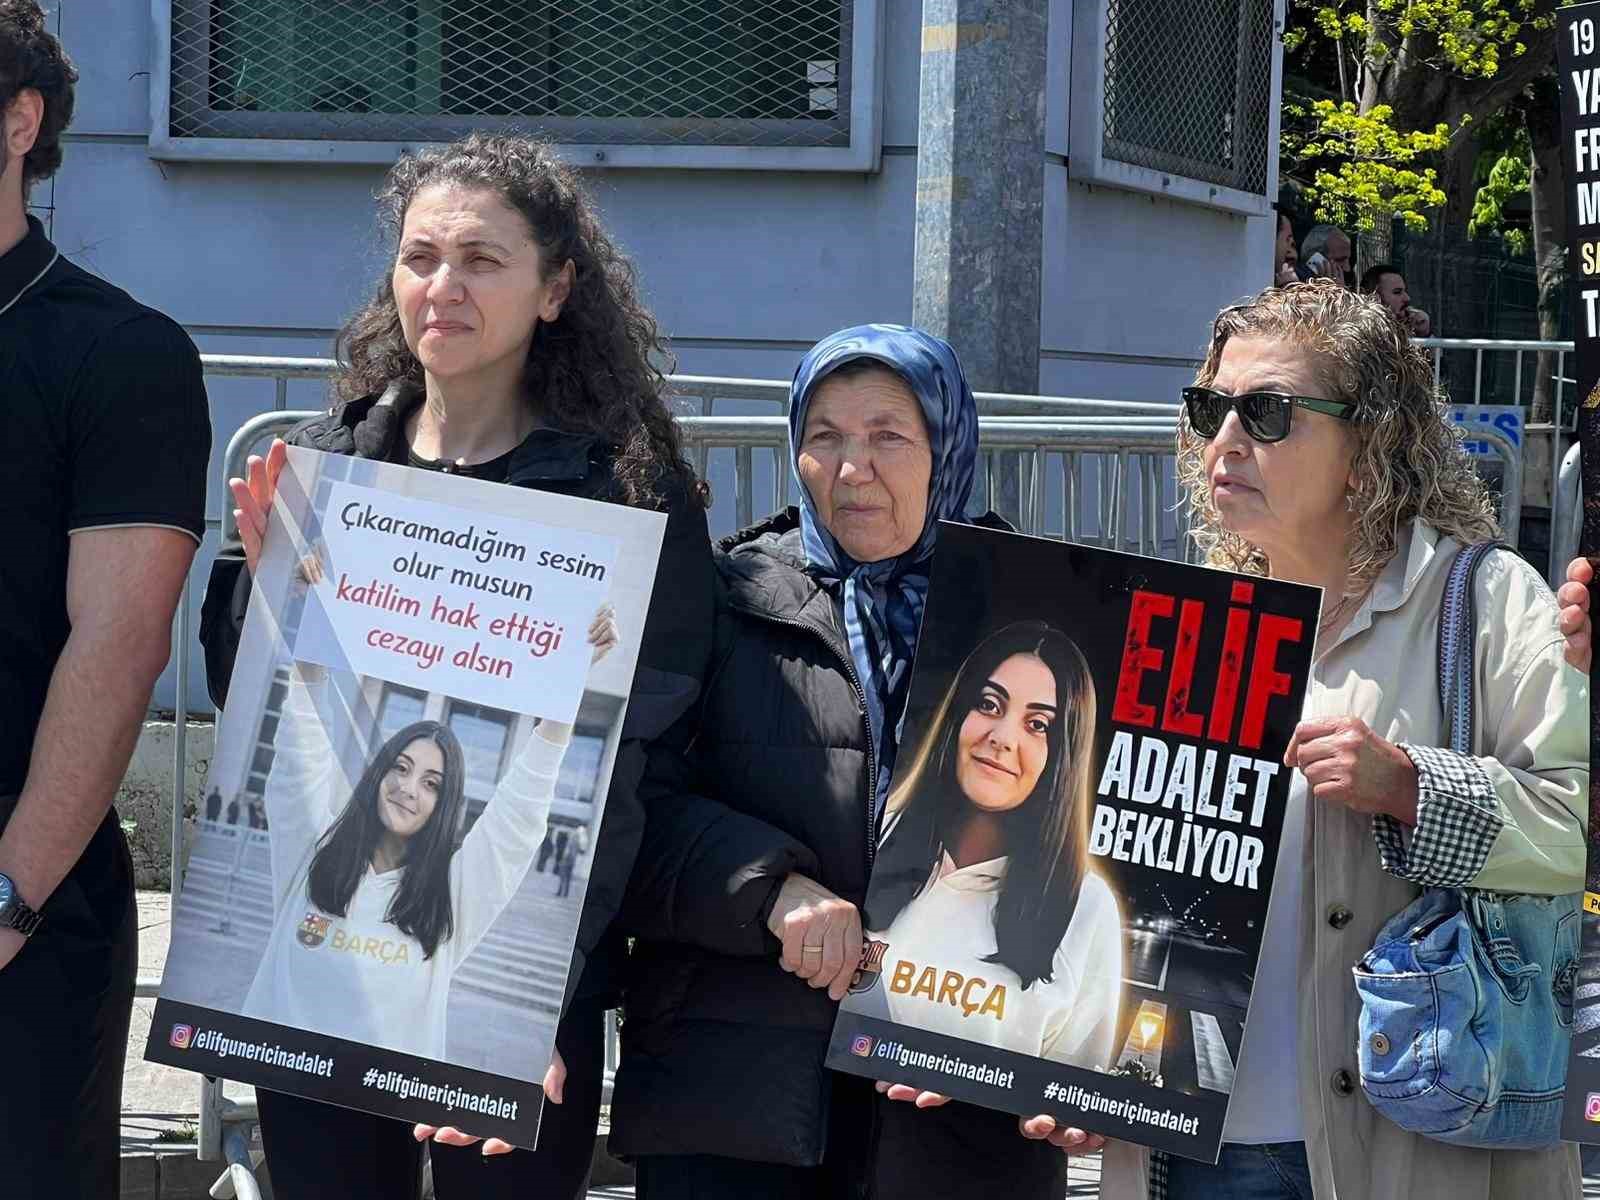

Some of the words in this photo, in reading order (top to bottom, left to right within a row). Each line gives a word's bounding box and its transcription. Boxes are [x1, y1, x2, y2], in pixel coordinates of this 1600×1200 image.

[1569, 18, 1594, 56] 19
[341, 502, 526, 562] Çıkaramadığım
[537, 549, 606, 581] sesim
[393, 552, 443, 581] olur
[450, 567, 533, 601] musun
[336, 573, 420, 617] katilim
[430, 595, 480, 630] hak
[488, 612, 564, 657] ettiği
[366, 626, 444, 669] cezayı
[453, 642, 513, 679] alsın
[1112, 580, 1303, 749] ELİF
[1098, 731, 1279, 827] ADALET
[1088, 803, 1264, 889] BEKLİYOR
[330, 928, 408, 964] BARÇA
[890, 960, 1006, 1020] BARÇA
[190, 1028, 334, 1077] /elifgunericinadalet
[871, 1039, 1015, 1089] /elifgunericinadalet
[363, 1068, 518, 1120] #elifgüneriçinadalet
[1044, 1082, 1199, 1135] #elifgüneriçinadalet
